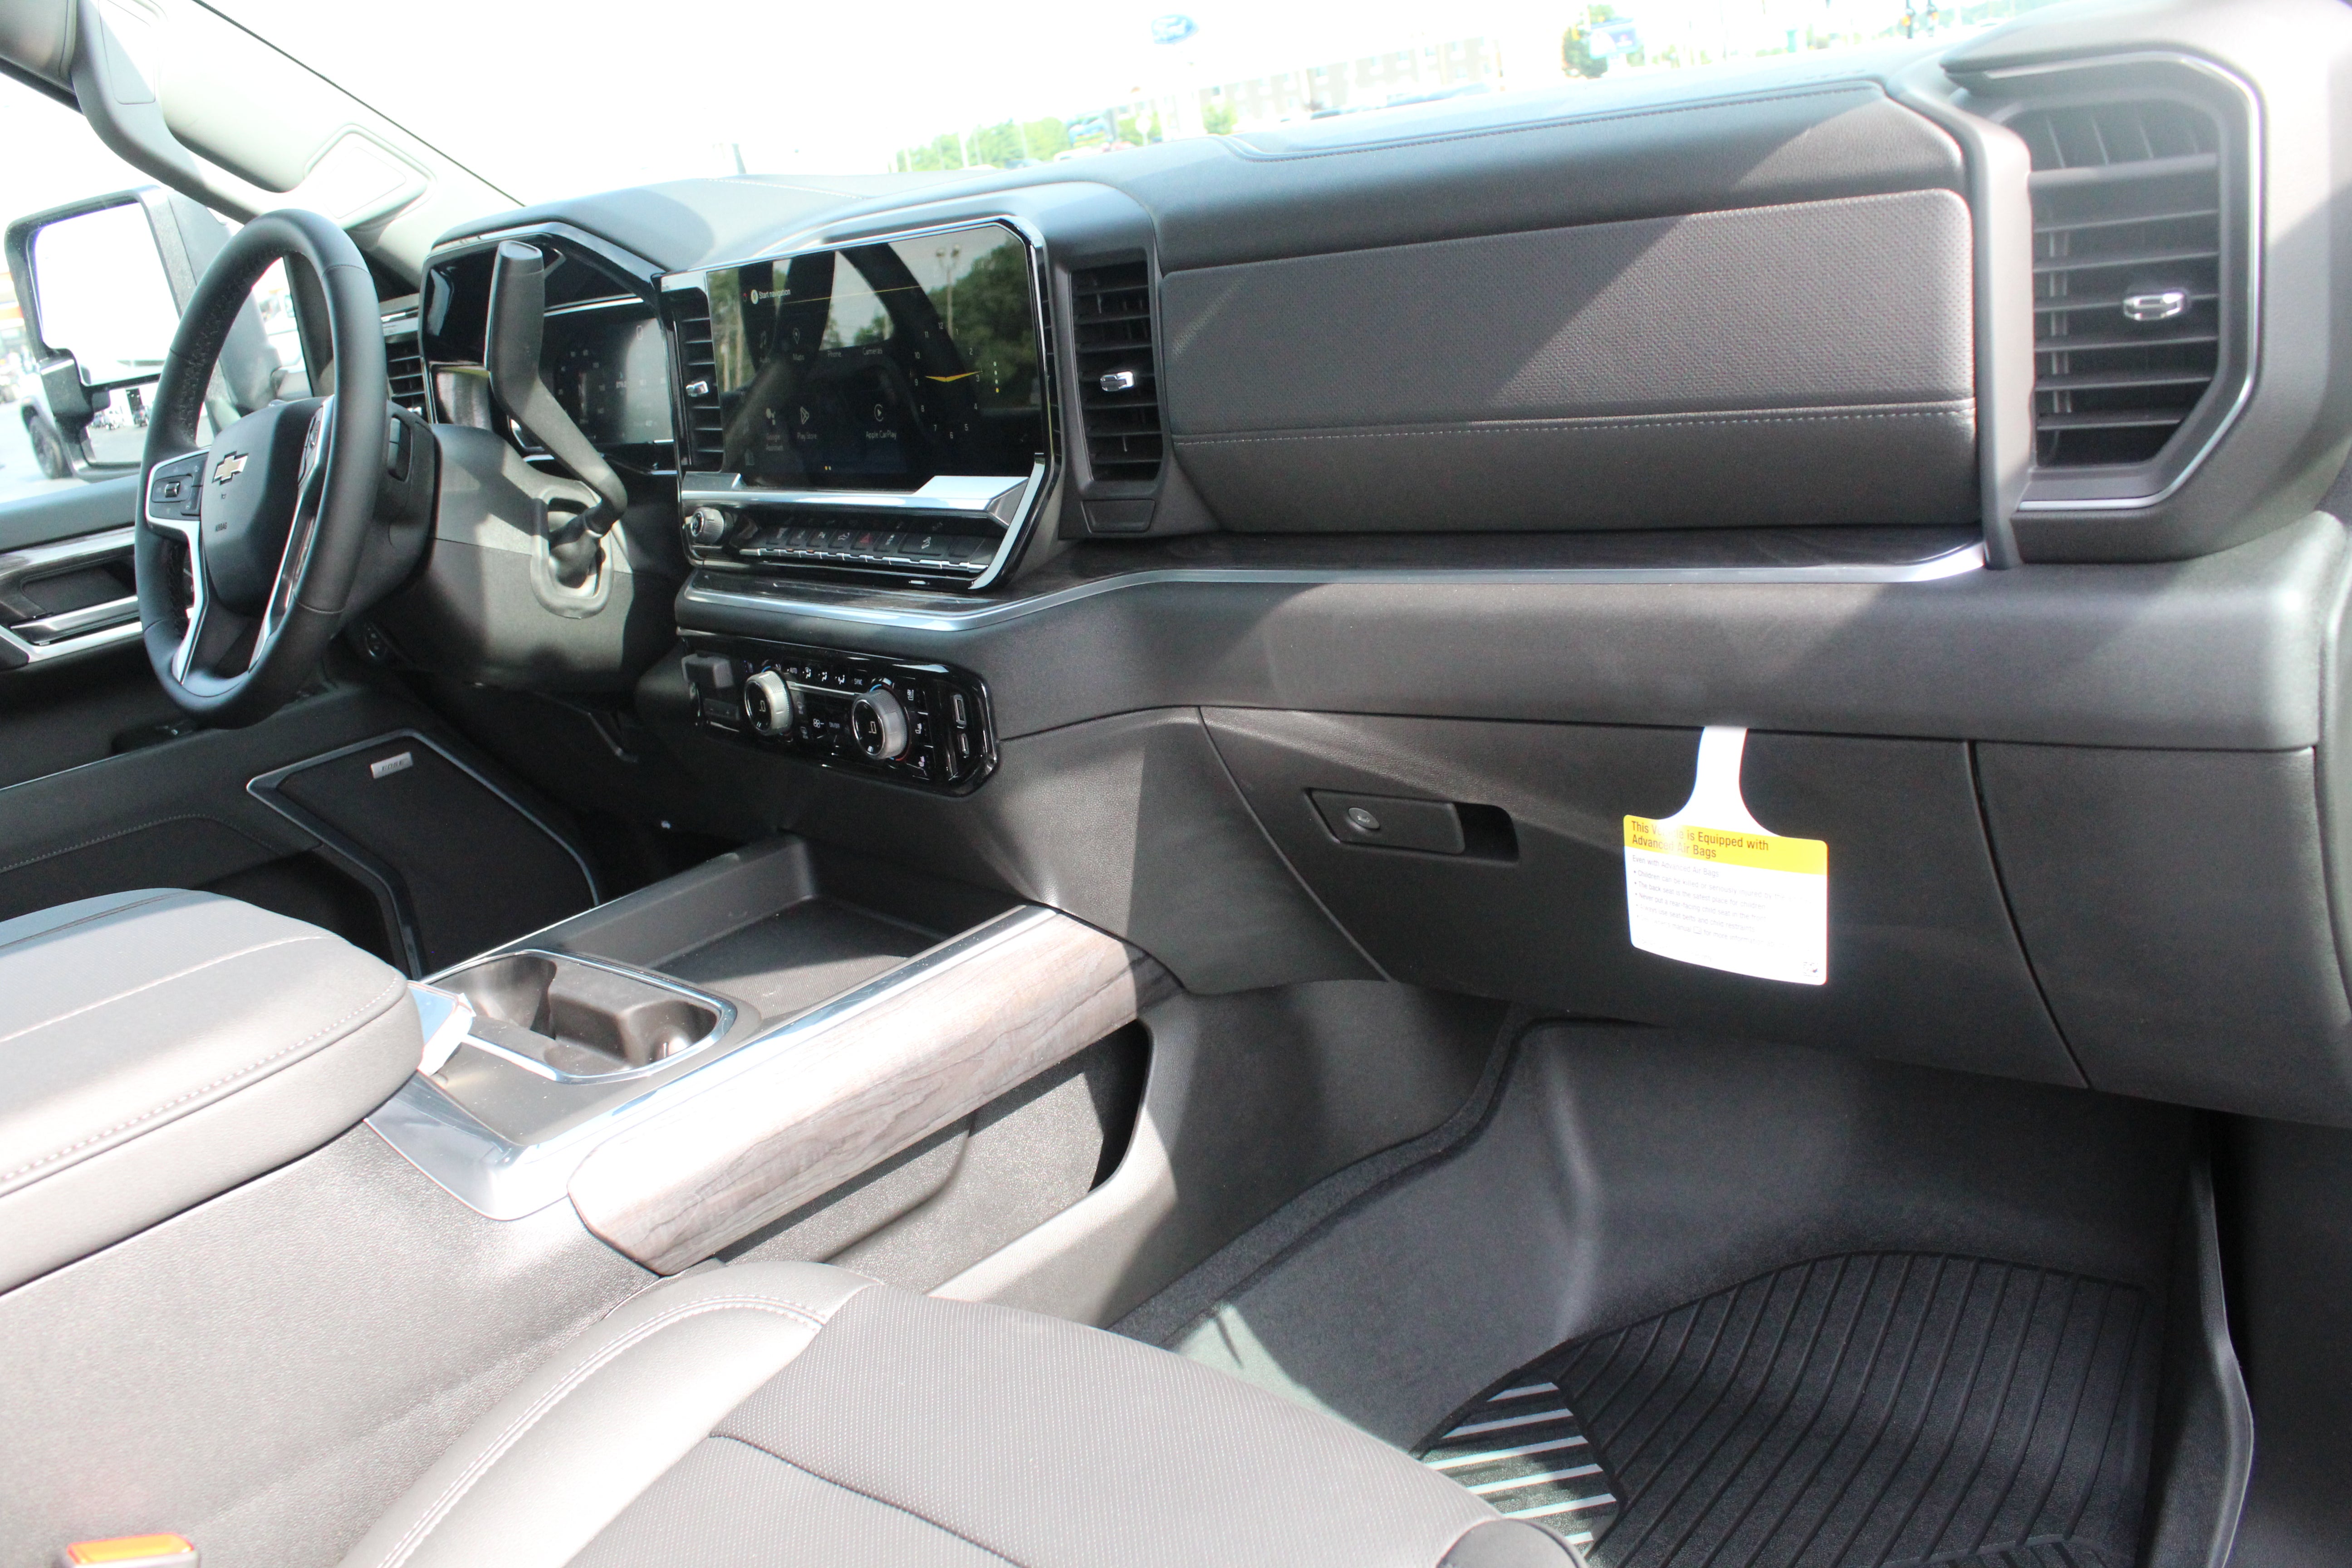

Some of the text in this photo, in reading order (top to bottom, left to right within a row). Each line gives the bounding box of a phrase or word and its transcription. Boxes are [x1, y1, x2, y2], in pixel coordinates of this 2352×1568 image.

[769, 289, 791, 298] navigation
[866, 431, 878, 439] Apple
[1632, 821, 1649, 833] This
[1687, 830, 1695, 841] is
[1698, 832, 1743, 848] Equipped
[1747, 838, 1769, 850] with
[1632, 834, 1716, 859] Advanced Air Bags
[1633, 855, 1646, 864] Even
[1661, 862, 1690, 872] Advanced
[1704, 868, 1719, 878] Bags
[1638, 870, 1660, 880] Children
[1683, 879, 1699, 888] killed
[1709, 885, 1737, 895] seriously
[1740, 889, 1762, 898] injured
[1639, 893, 1653, 901] Never
[1670, 900, 1700, 912] rear-facing
[1702, 906, 1716, 914] child
[1740, 901, 1765, 910] children
